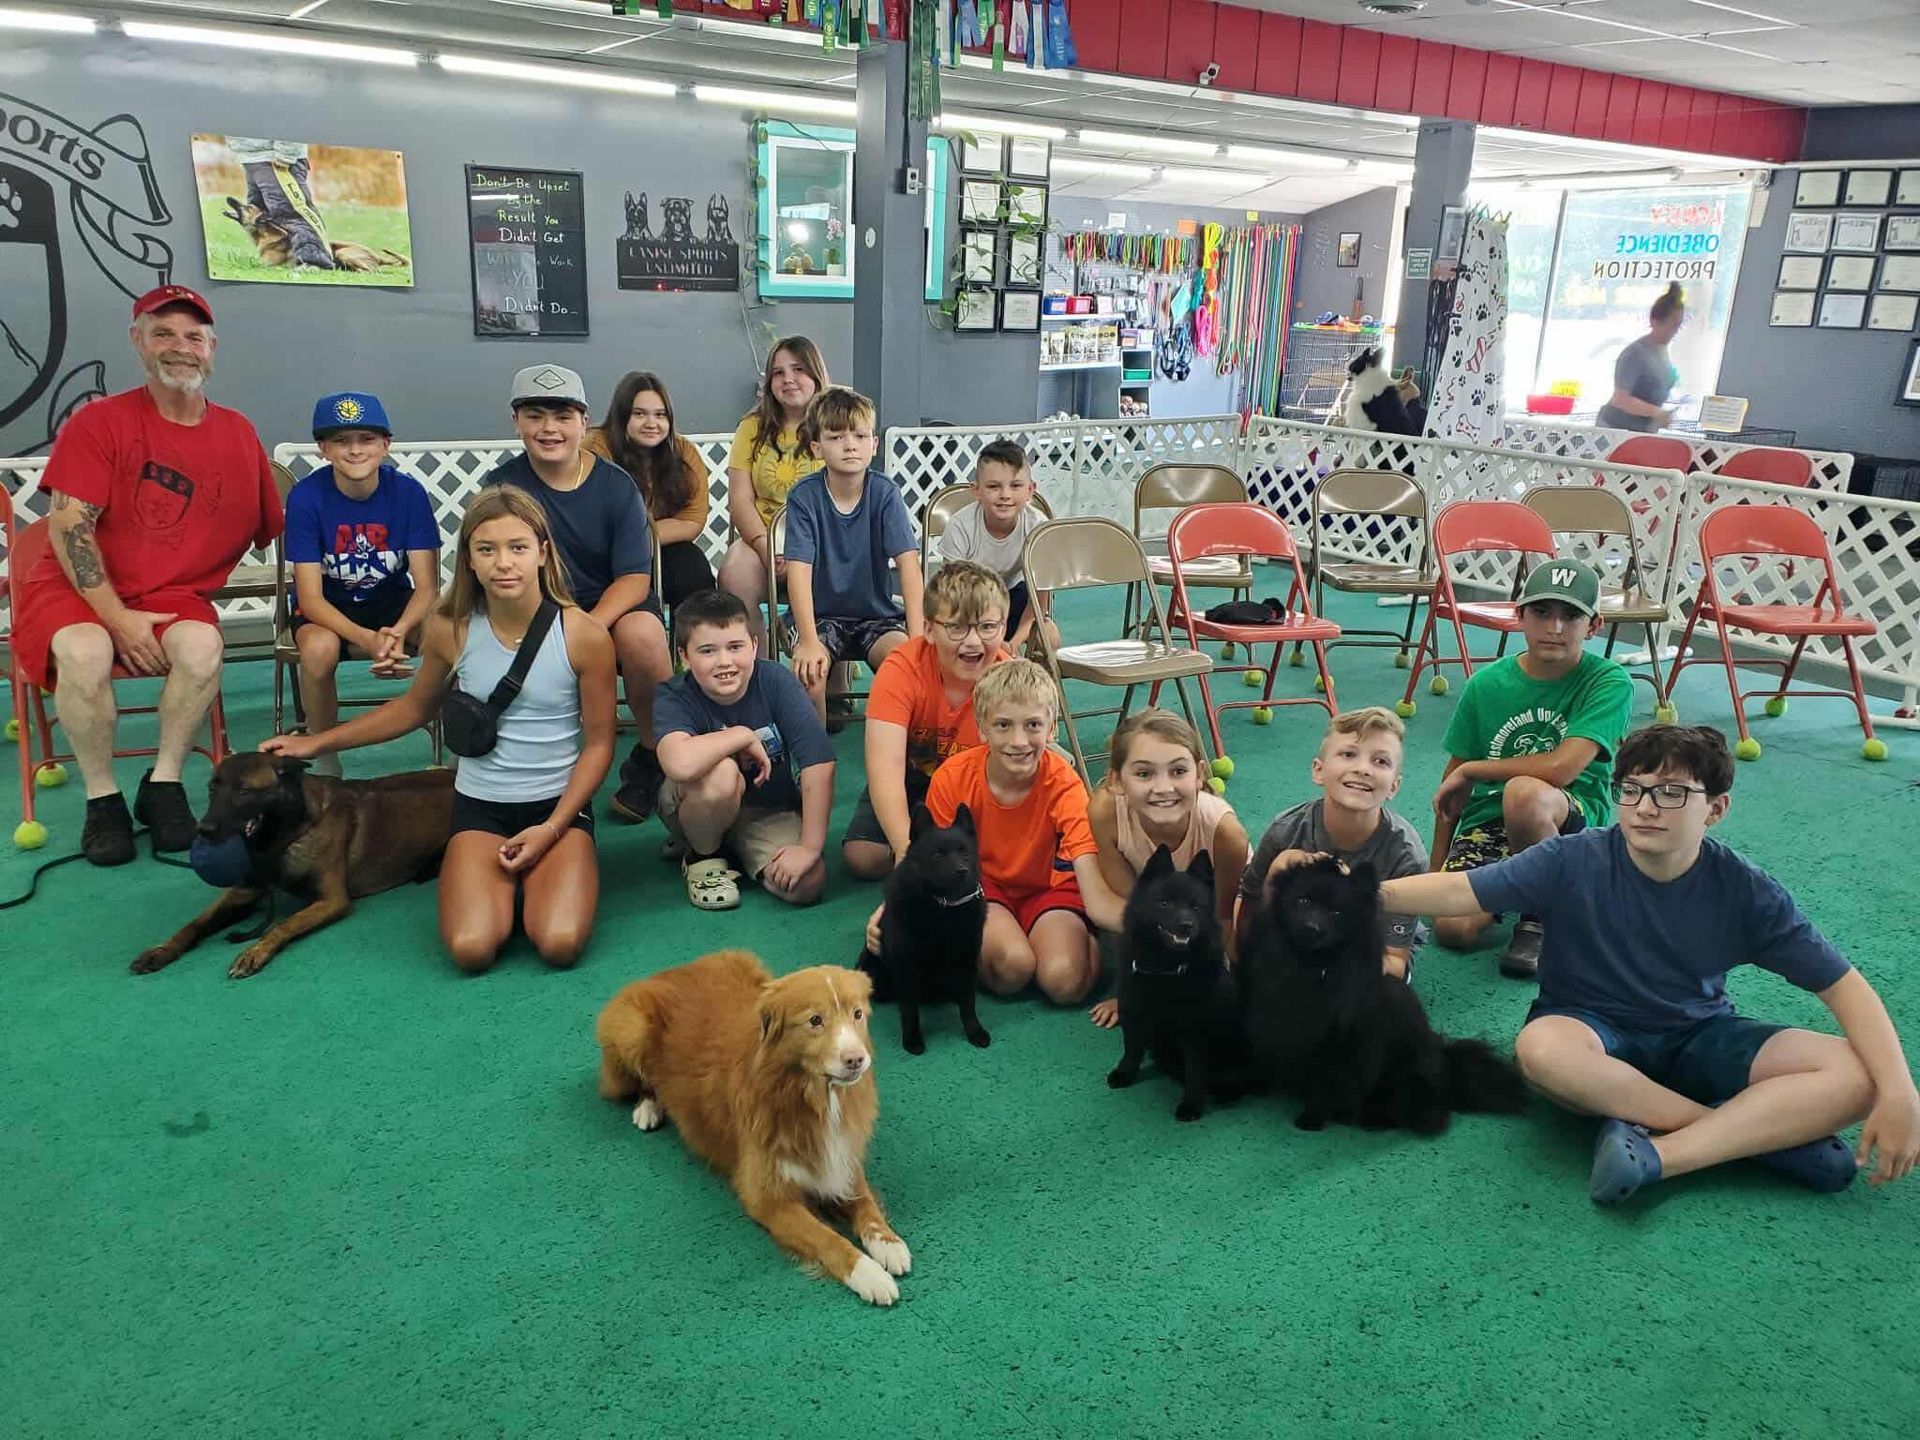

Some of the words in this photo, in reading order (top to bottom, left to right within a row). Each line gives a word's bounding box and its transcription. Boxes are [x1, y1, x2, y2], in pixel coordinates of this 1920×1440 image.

[475, 173, 507, 187] Don't
[515, 177, 531, 189] Be
[538, 179, 570, 193] Upset
[523, 194, 542, 205] the
[496, 209, 536, 223] Result
[498, 227, 537, 243] Didn't
[543, 232, 566, 243] Get
[1551, 568, 1577, 587] W
[1487, 709, 1535, 760] estmoreland
